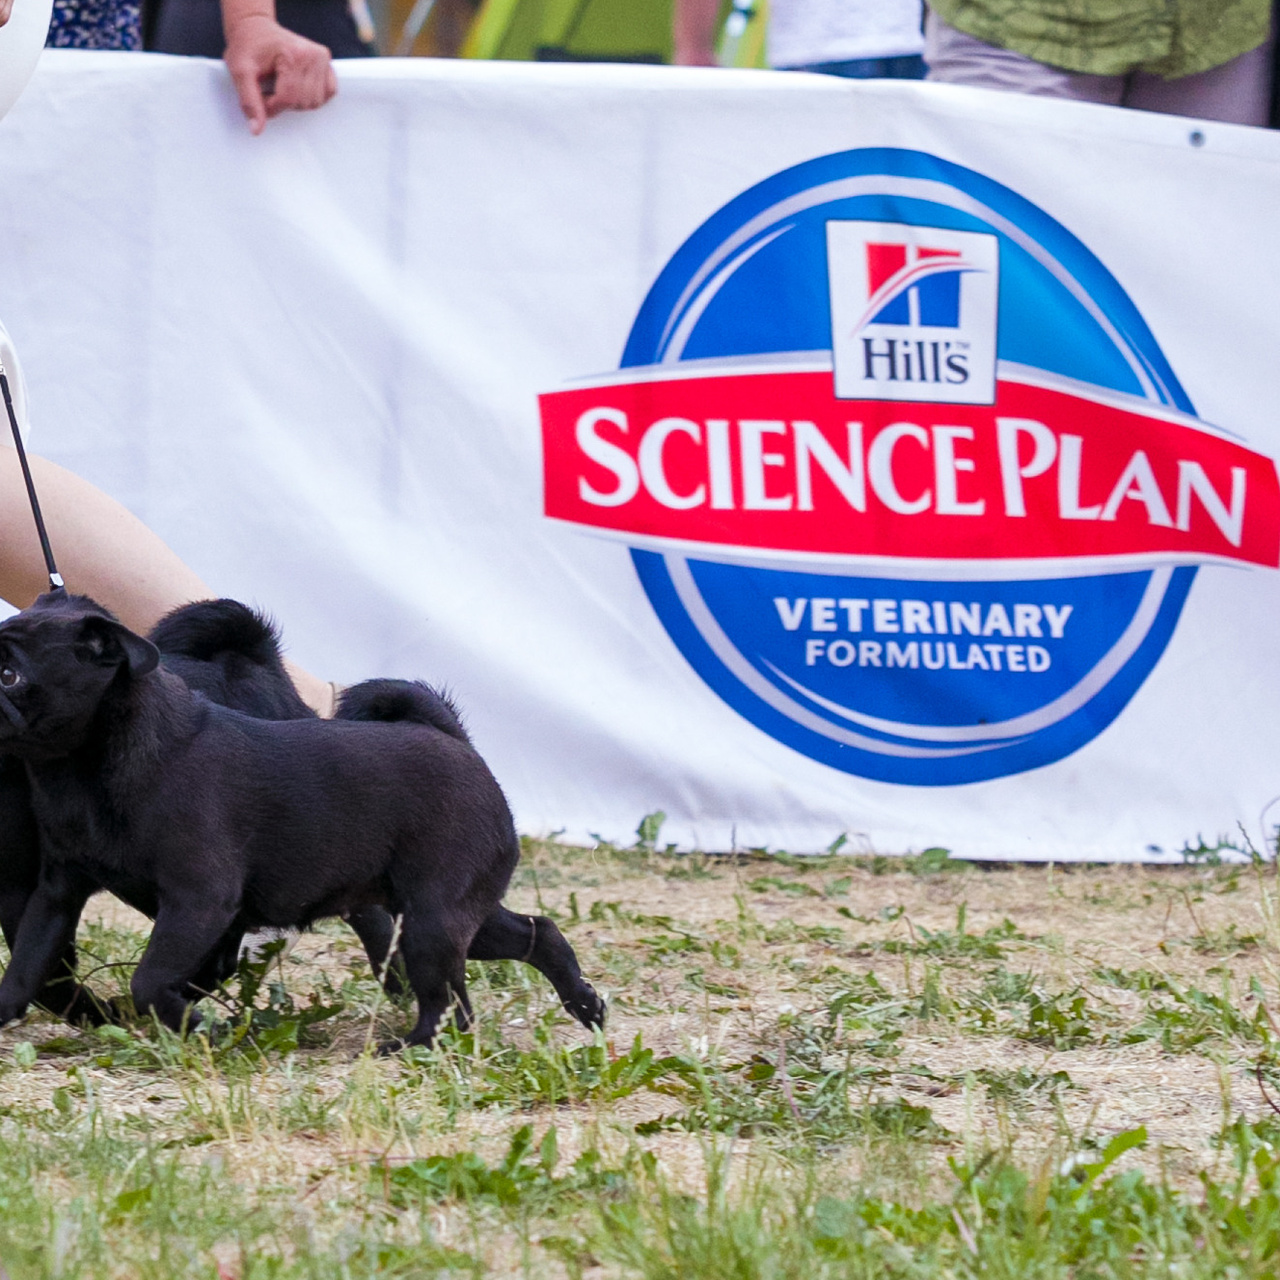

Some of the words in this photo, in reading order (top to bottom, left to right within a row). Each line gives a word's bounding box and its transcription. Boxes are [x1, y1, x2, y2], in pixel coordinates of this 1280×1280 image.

[862, 337, 970, 385] Hill's
[575, 406, 986, 516] SCIENCE
[995, 416, 1247, 548] PLAN
[773, 597, 1074, 639] VETERINARY
[805, 639, 1052, 673] FORMULATED
